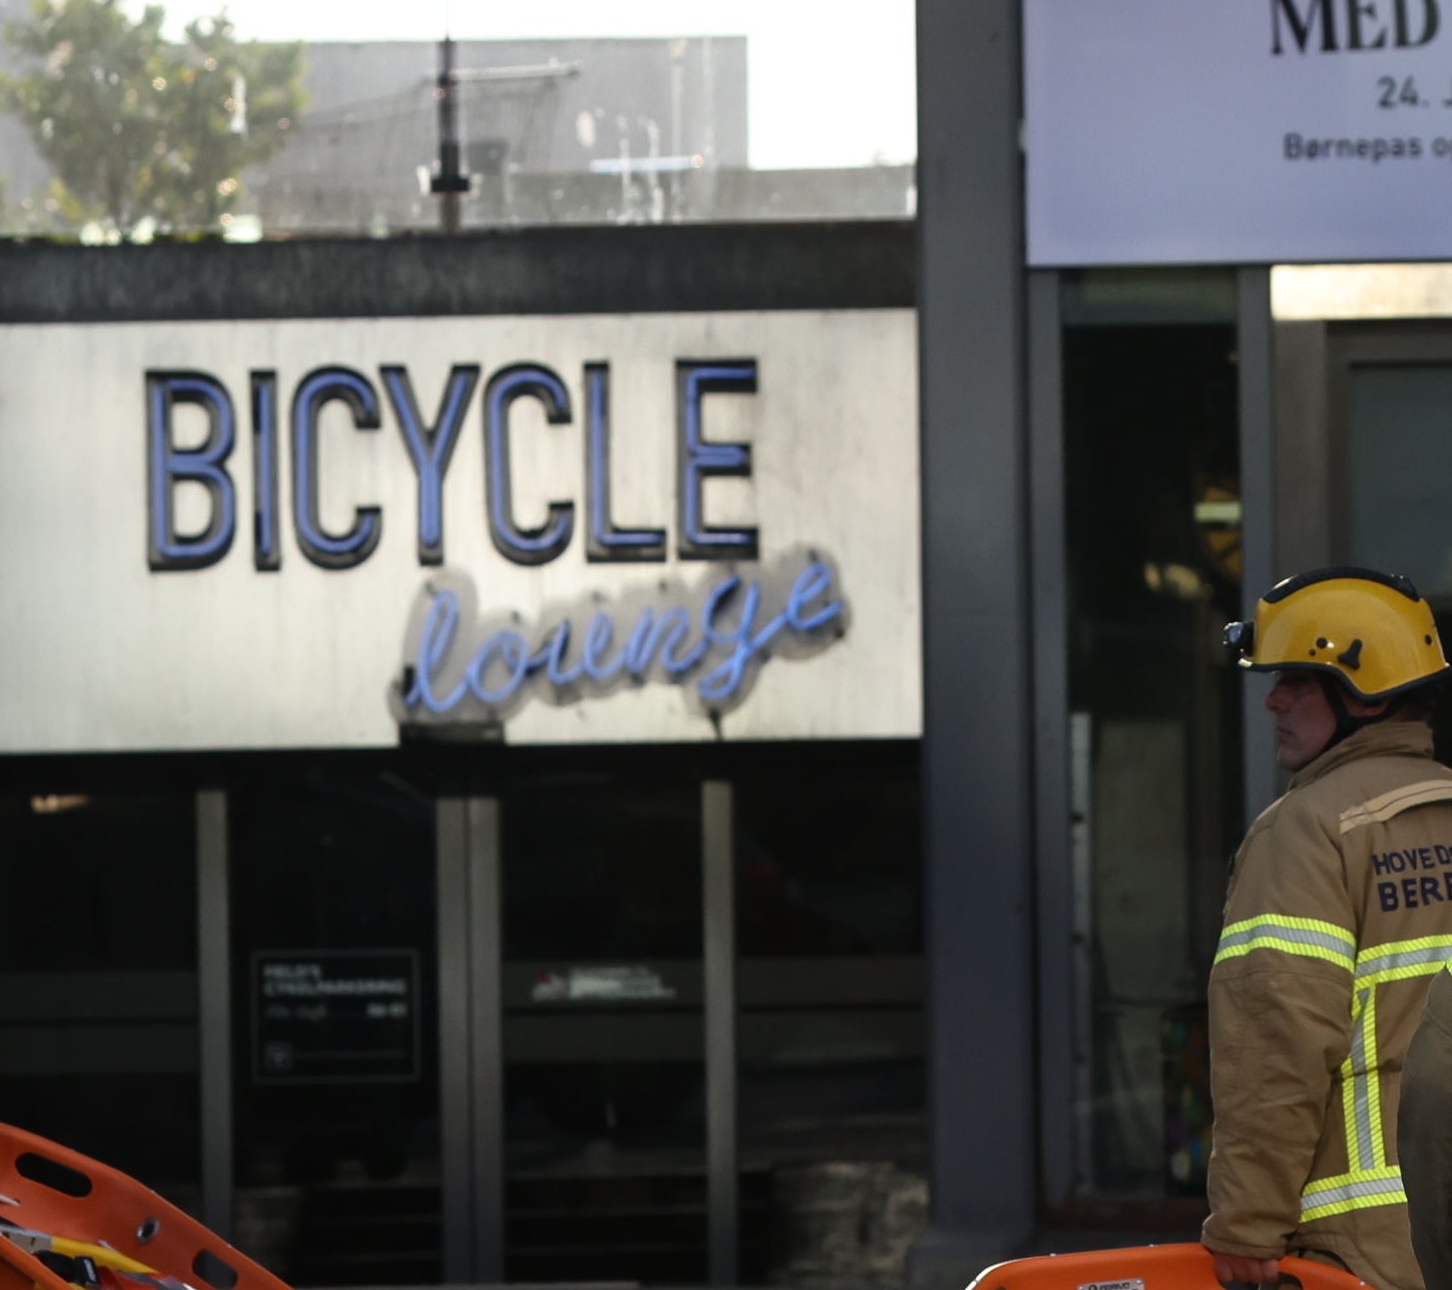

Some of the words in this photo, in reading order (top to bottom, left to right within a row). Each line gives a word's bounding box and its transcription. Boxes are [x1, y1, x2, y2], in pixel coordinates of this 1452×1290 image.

[1376, 75, 1432, 110] 24.
[1282, 131, 1422, 163] Børnepas
[143, 358, 760, 573] BICYCLE
[402, 555, 844, 712] lounge
